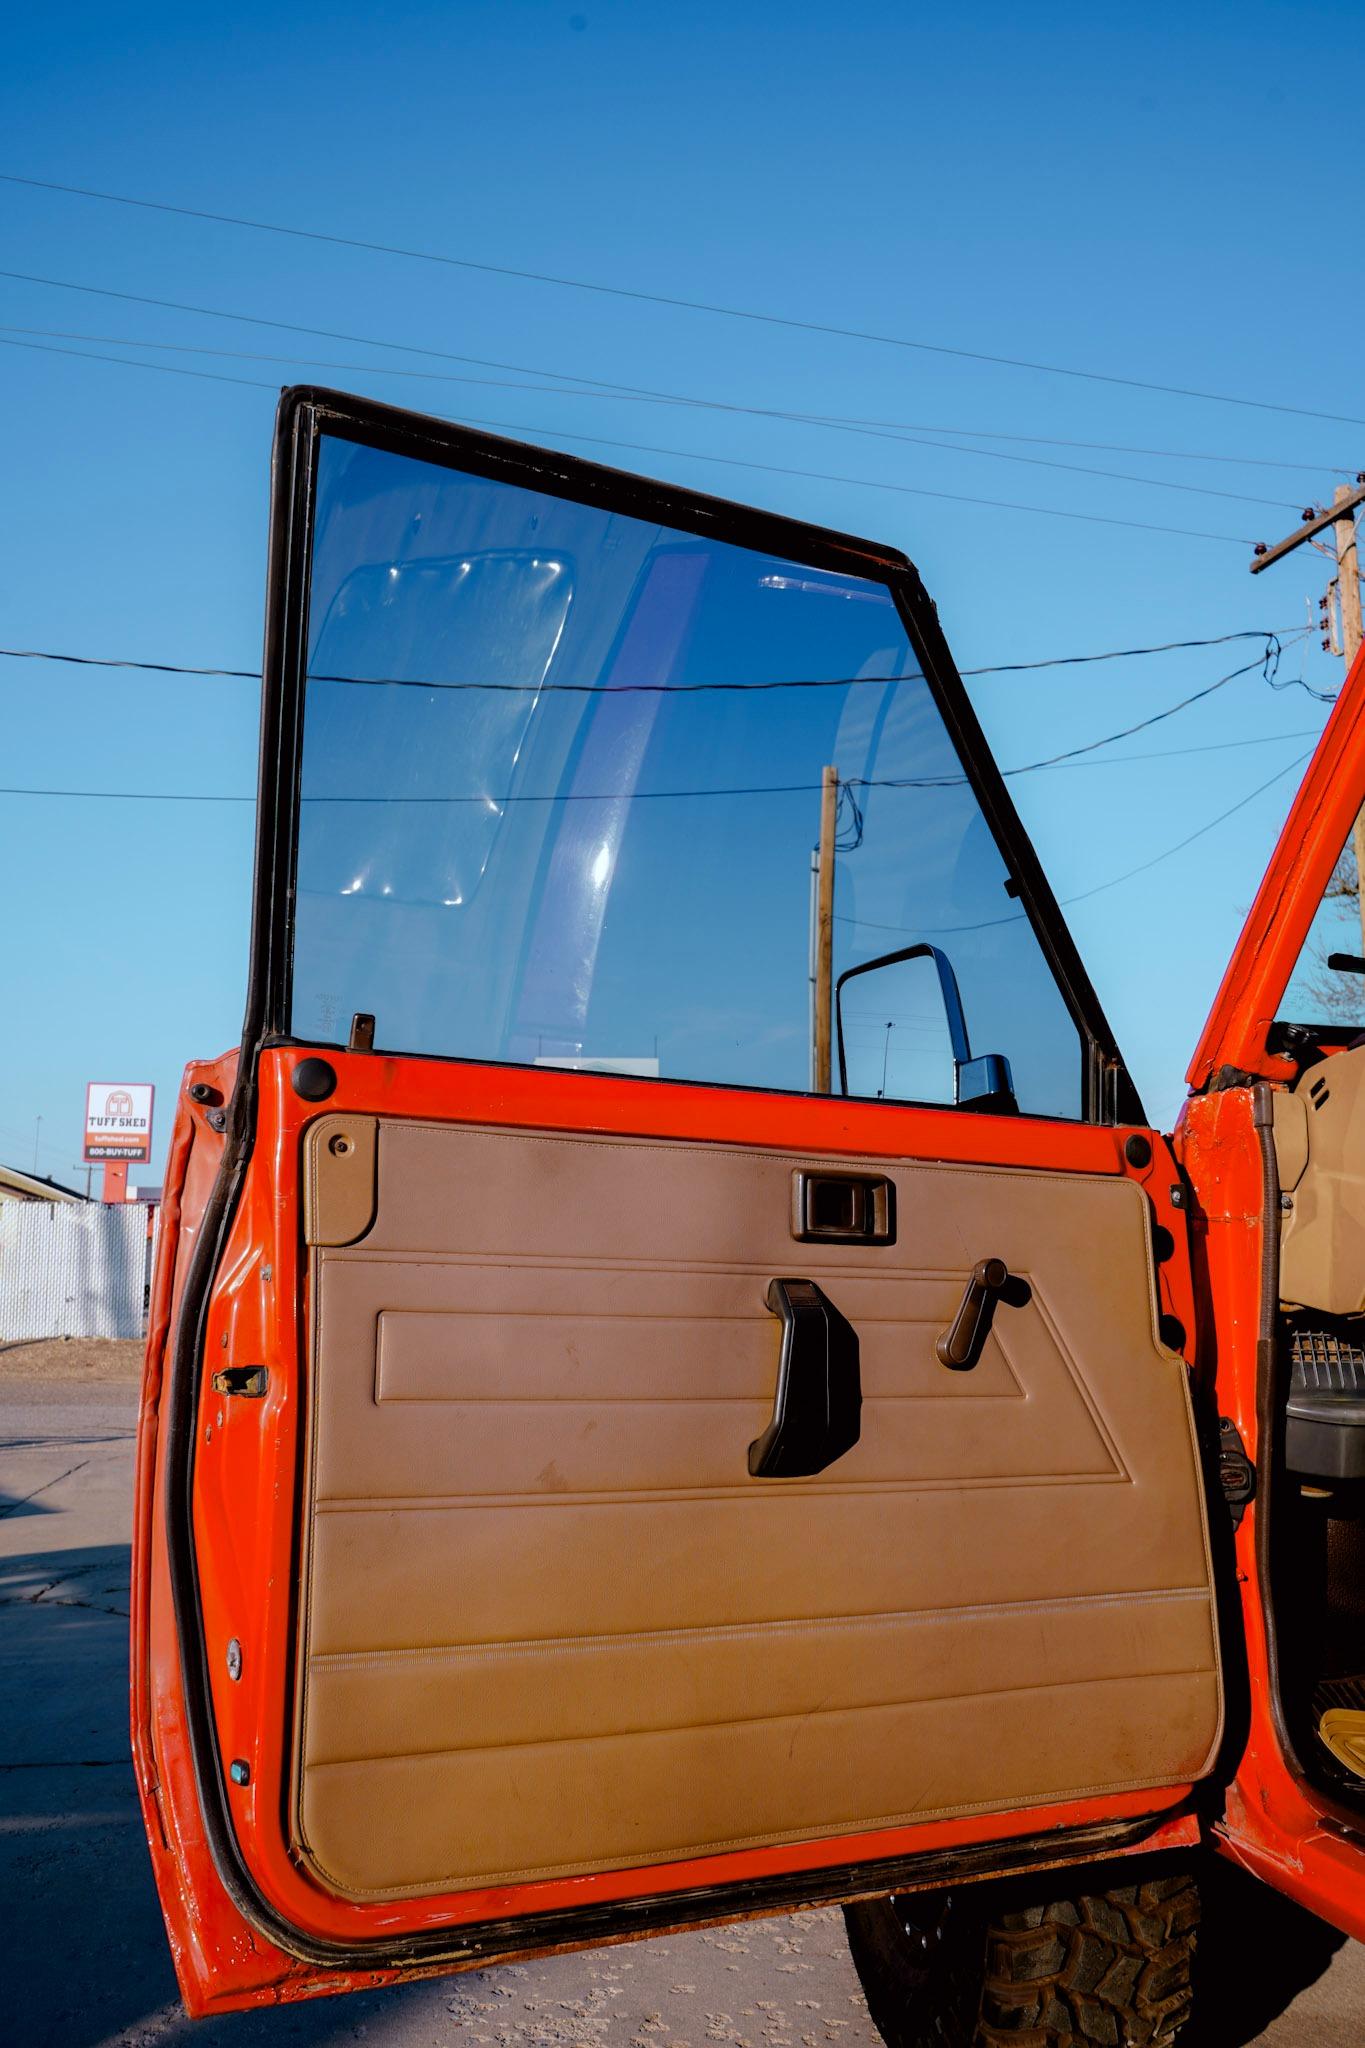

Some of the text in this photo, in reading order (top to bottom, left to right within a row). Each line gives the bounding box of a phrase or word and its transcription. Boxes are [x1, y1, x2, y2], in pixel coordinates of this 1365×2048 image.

[88, 1117, 146, 1127] TUFF SHED
[94, 1135, 139, 1143] tuffshed.com
[89, 1147, 142, 1157] 800-BUY-TUFF
